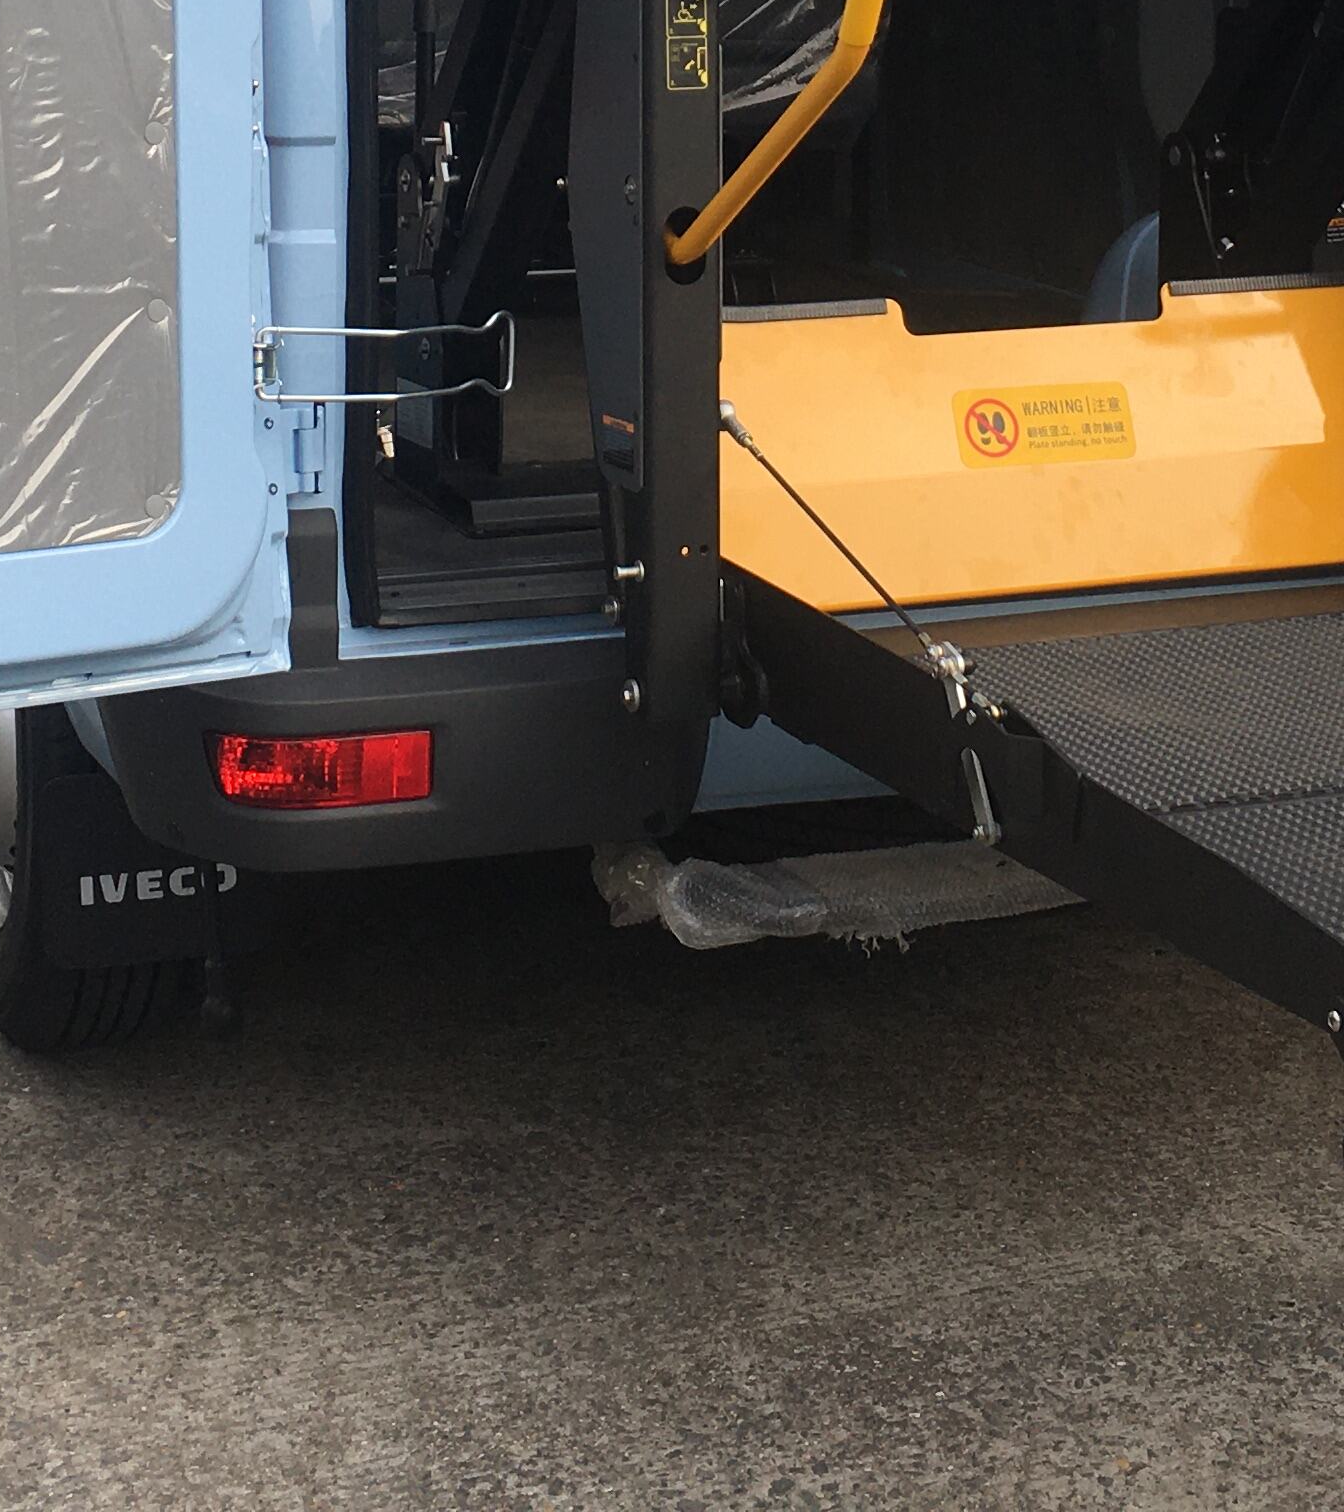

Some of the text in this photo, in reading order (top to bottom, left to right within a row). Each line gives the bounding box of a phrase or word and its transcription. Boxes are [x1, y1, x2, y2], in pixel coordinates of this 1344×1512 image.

[1022, 396, 1122, 416] WARNING 注意
[1029, 440, 1049, 449] Plate
[1103, 434, 1128, 444] touch
[79, 862, 238, 906] IVECO
